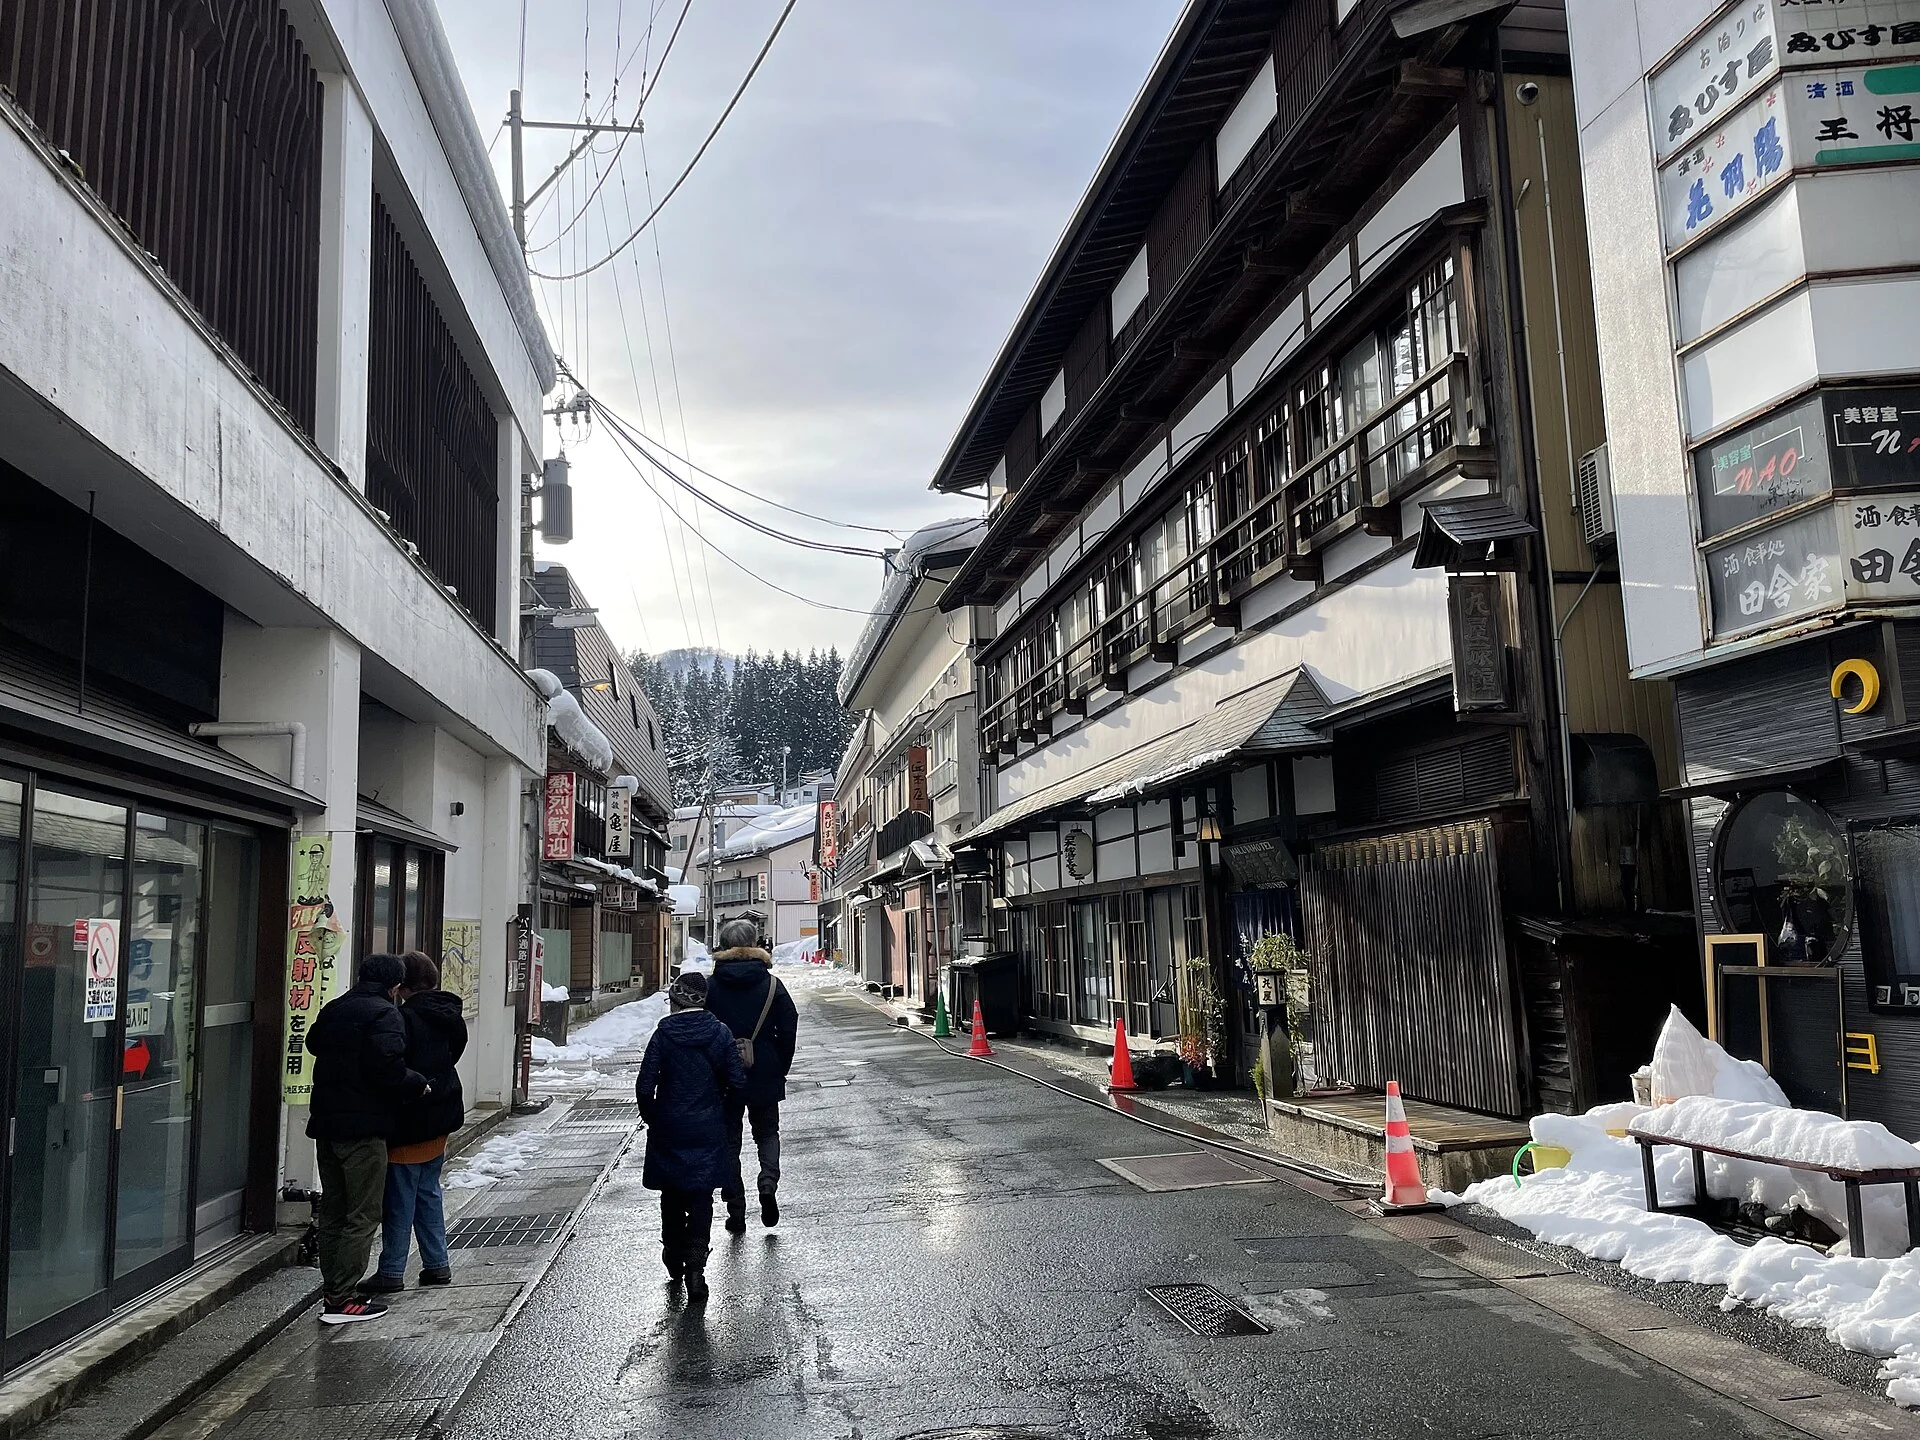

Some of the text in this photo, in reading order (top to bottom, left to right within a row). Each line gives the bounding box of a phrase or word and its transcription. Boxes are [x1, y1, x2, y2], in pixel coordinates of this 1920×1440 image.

[1699, 2, 1766, 70] お泊りは
[1806, 81, 1855, 100] 清酒
[1815, 105, 1920, 142] 王将
[1678, 147, 1705, 176] 清酒
[1844, 406, 1899, 424] 美容室
[1716, 444, 1752, 472] 美容室
[1739, 552, 1833, 616] 田舎家
[547, 774, 570, 858] 熱烈歓迎
